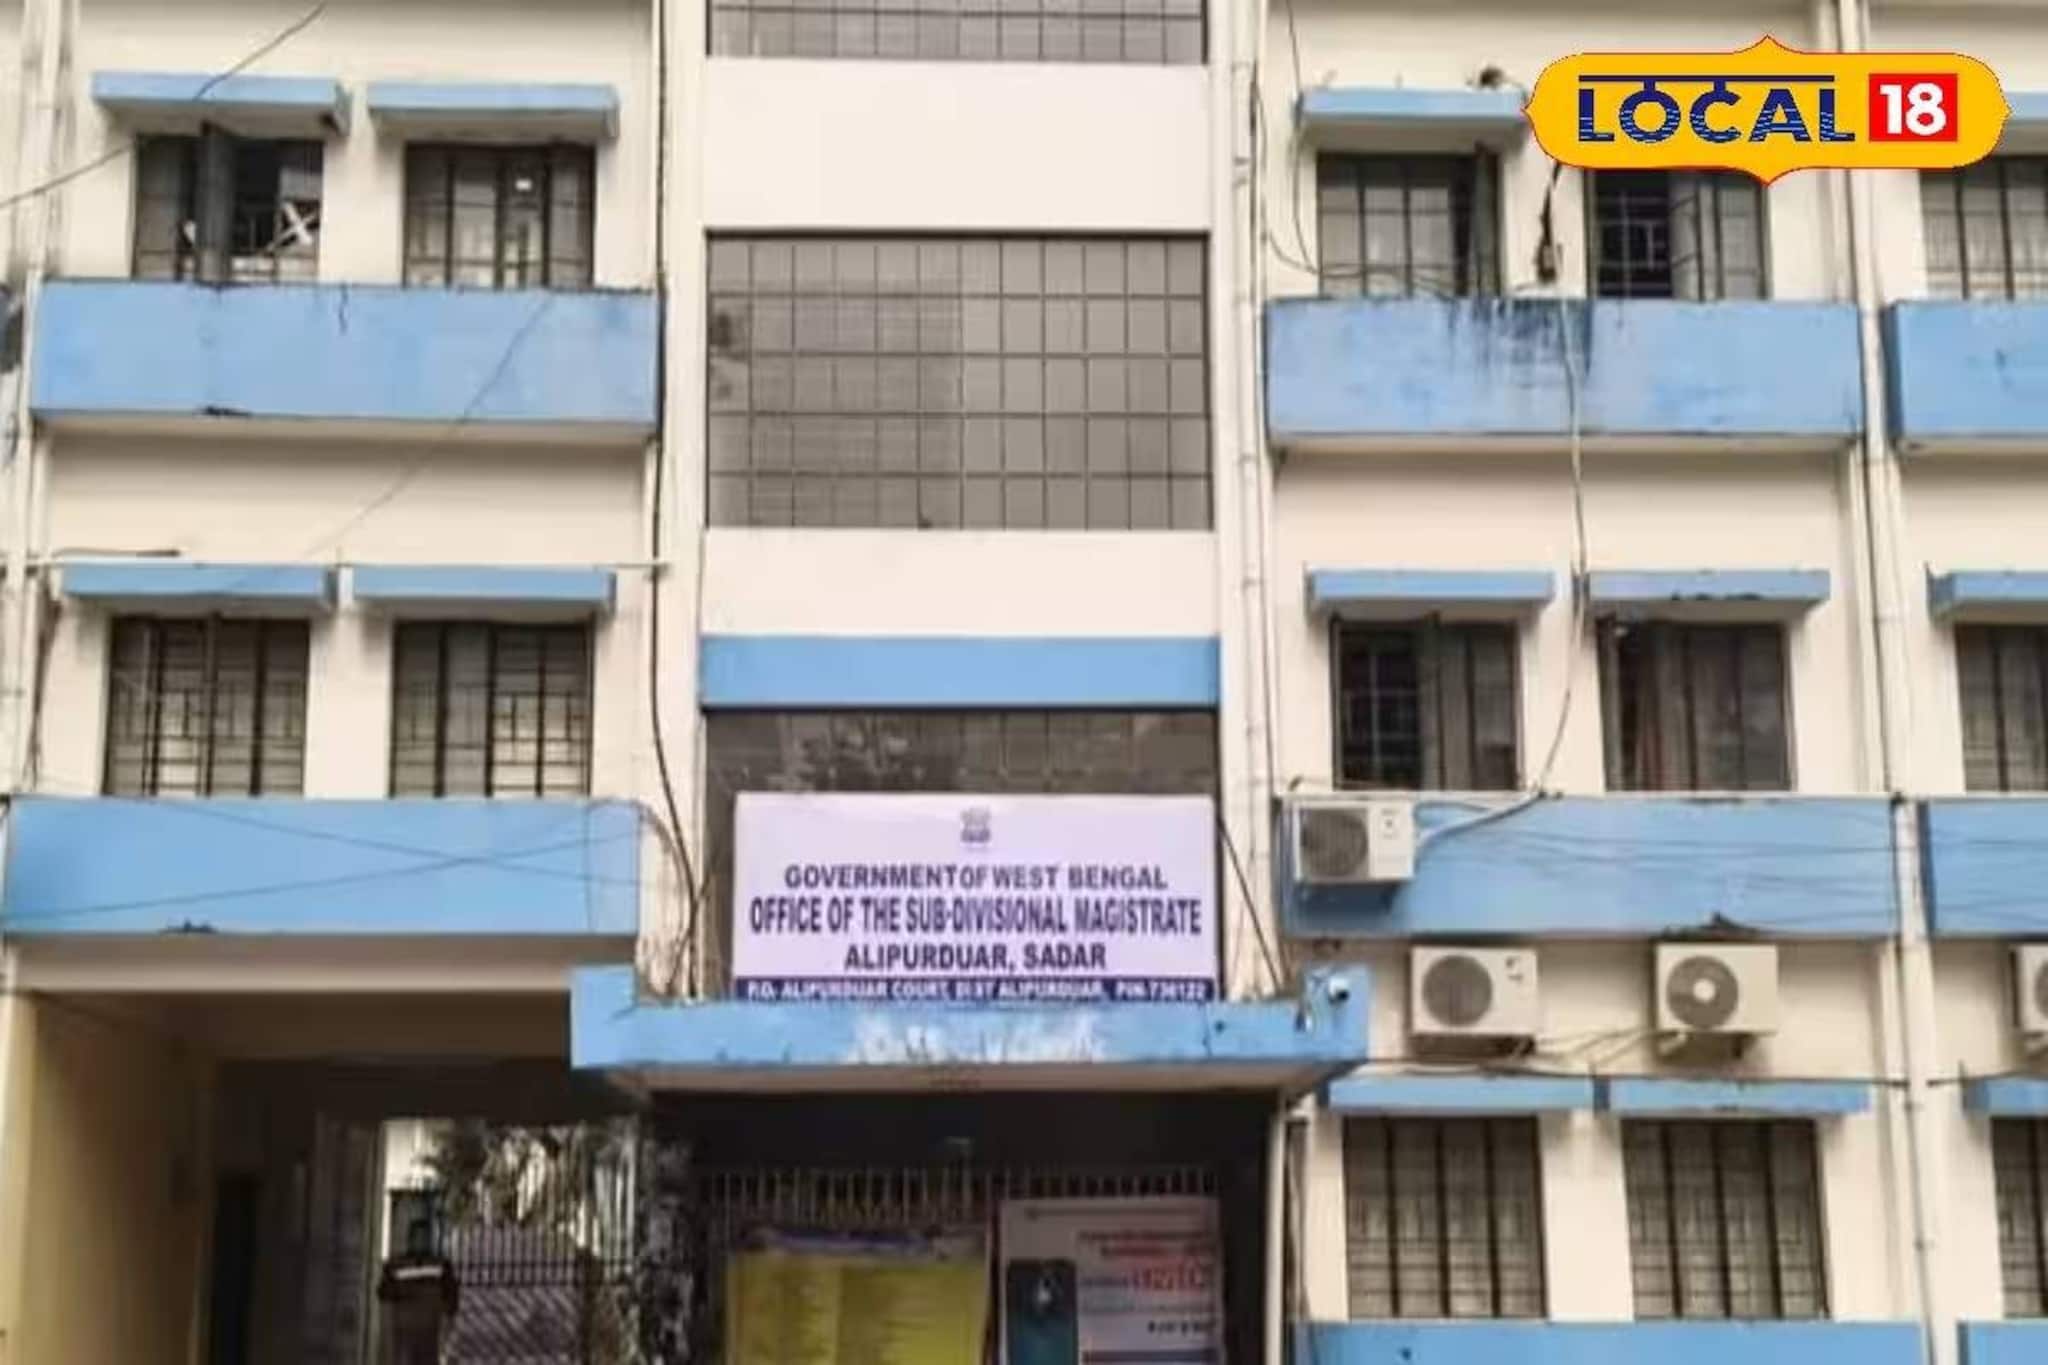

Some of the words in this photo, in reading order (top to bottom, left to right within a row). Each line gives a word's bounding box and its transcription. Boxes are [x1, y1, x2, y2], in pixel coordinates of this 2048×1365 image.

[784, 865, 957, 889] GOVERNMENT
[959, 865, 986, 888] OF
[992, 865, 1058, 889] WEST
[1068, 865, 1168, 890] BENGAL
[751, 897, 822, 933] OFFICE
[827, 897, 854, 933] OF
[860, 897, 901, 933] THE
[906, 897, 1067, 933] SUB-DIVISIONAL
[1074, 898, 1202, 934] MAGISTRATE
[844, 944, 1016, 970] ALIPURDUAR,
[1023, 944, 1106, 969] SADAR
